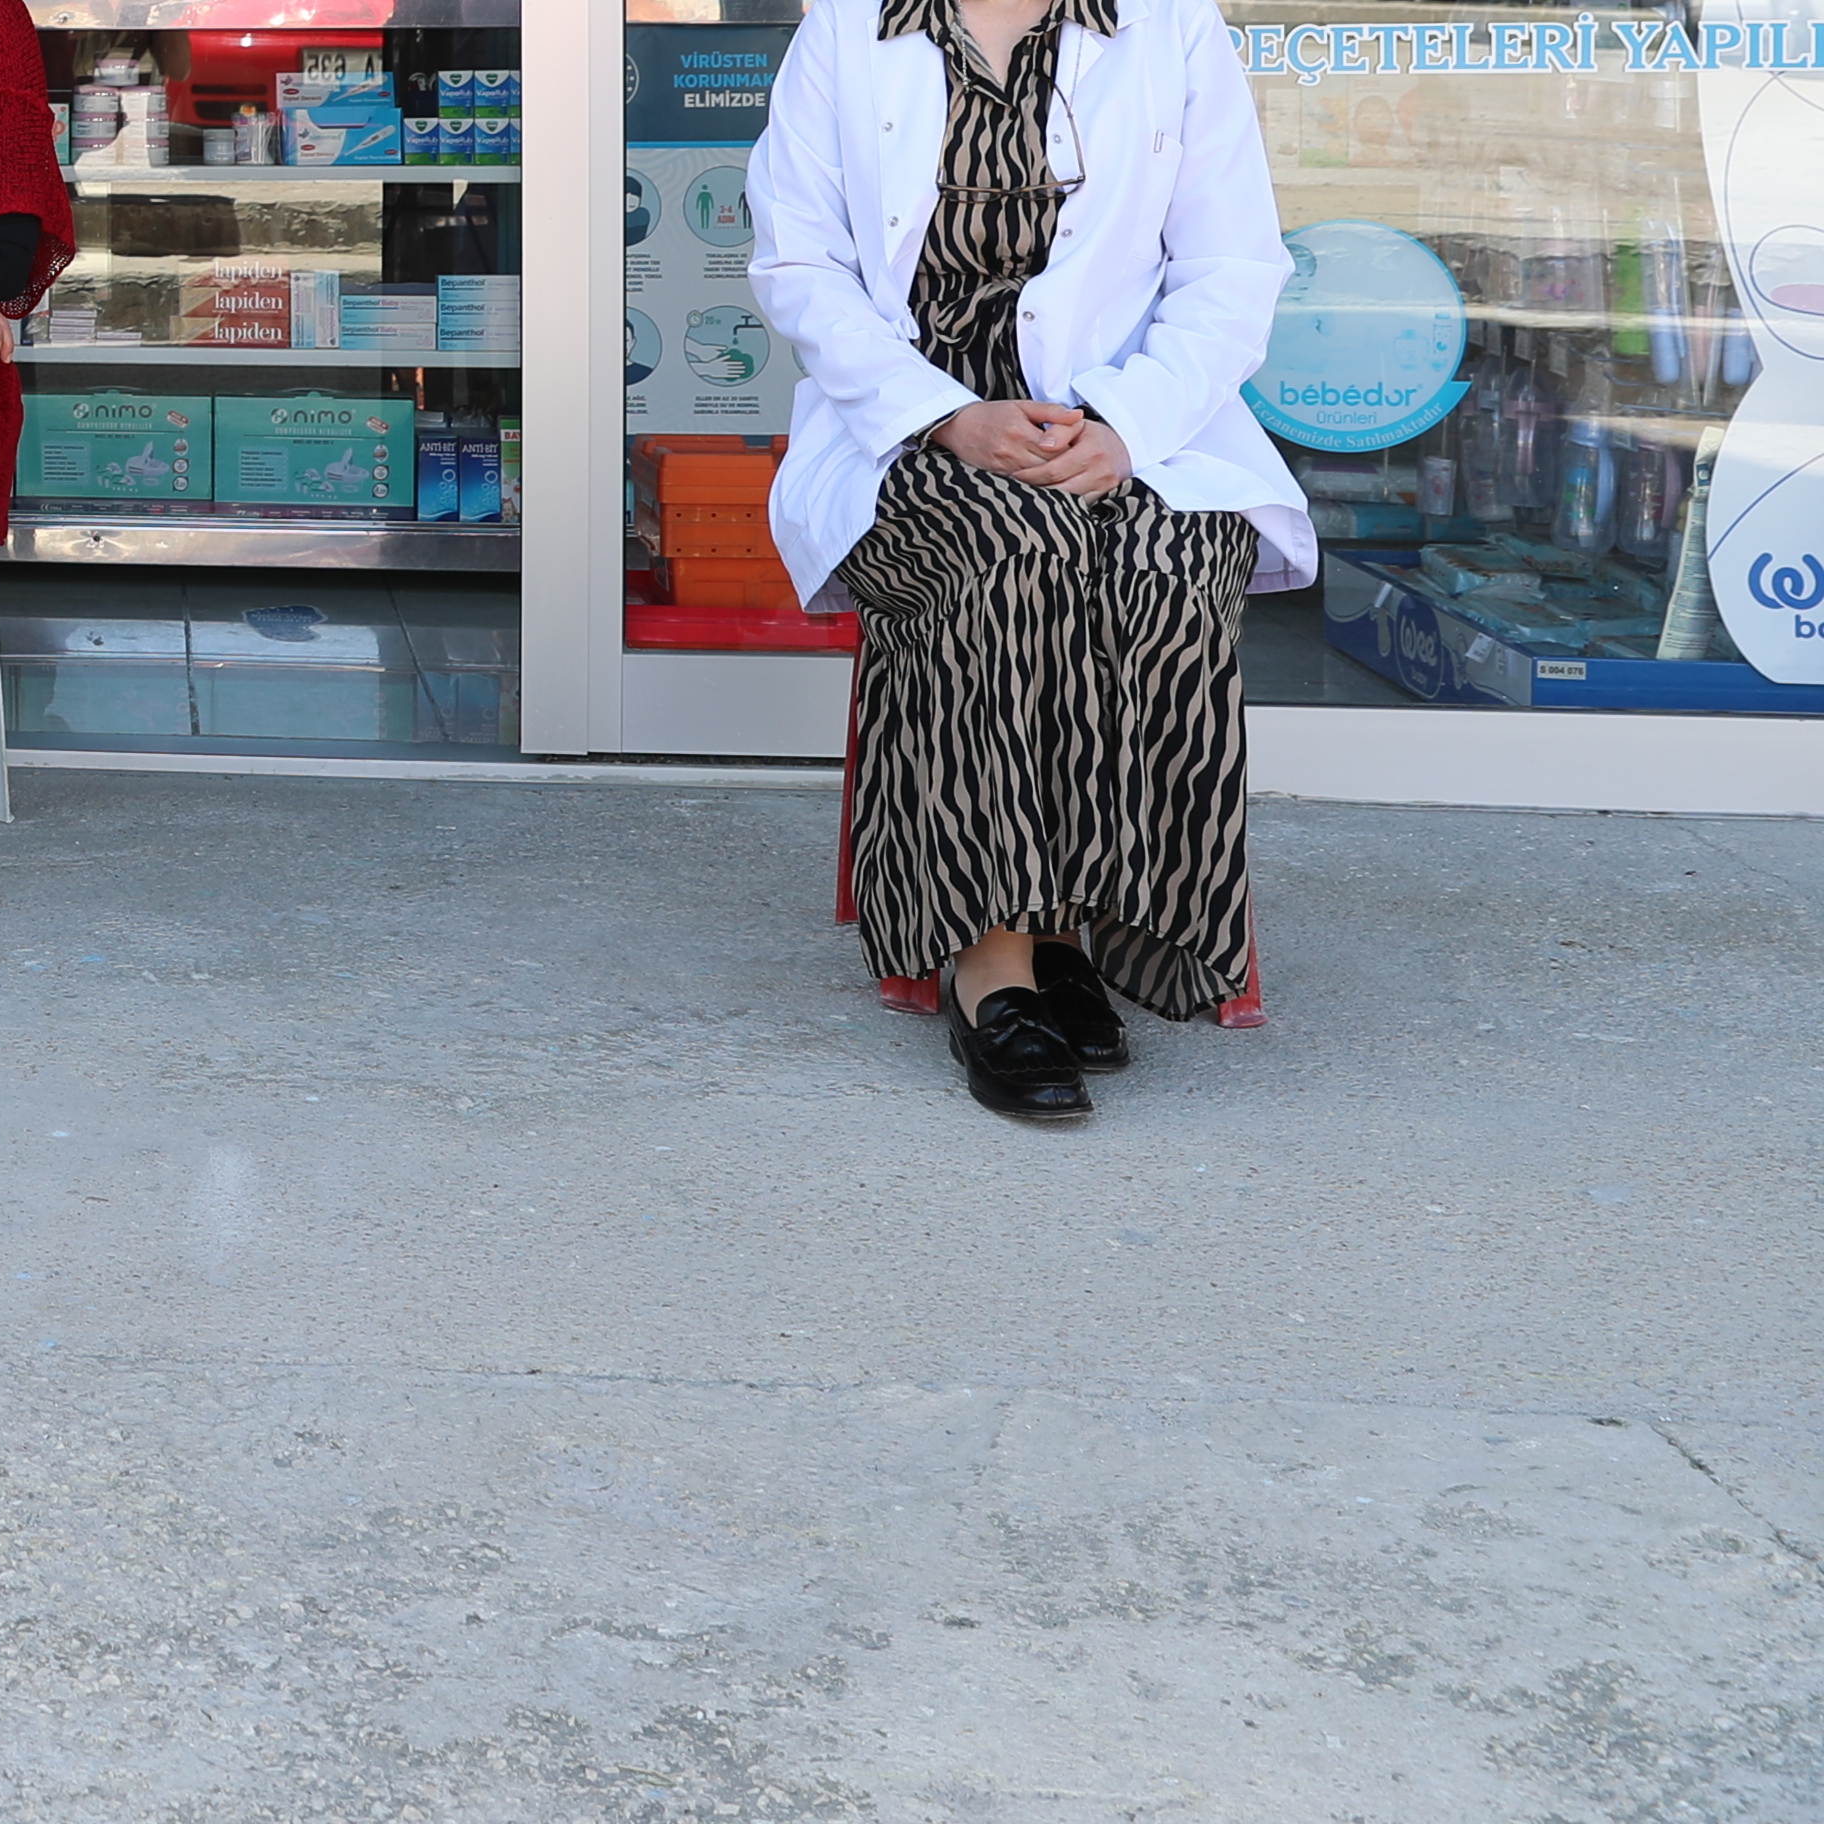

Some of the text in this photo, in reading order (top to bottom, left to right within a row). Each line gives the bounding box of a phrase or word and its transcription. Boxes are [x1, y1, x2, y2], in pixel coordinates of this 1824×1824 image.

[680, 51, 768, 68] VİRÜSTEN
[684, 90, 766, 108] ELİMİZDE
[214, 259, 283, 283] lapiden
[440, 278, 485, 288] Bepanthol
[214, 291, 284, 313] lapiden
[440, 303, 485, 313] Bepanthol
[213, 322, 283, 344] lapiden
[439, 328, 485, 338] Bepanthol
[1252, 399, 1444, 448] Eczanemizde Satılmaktadır
